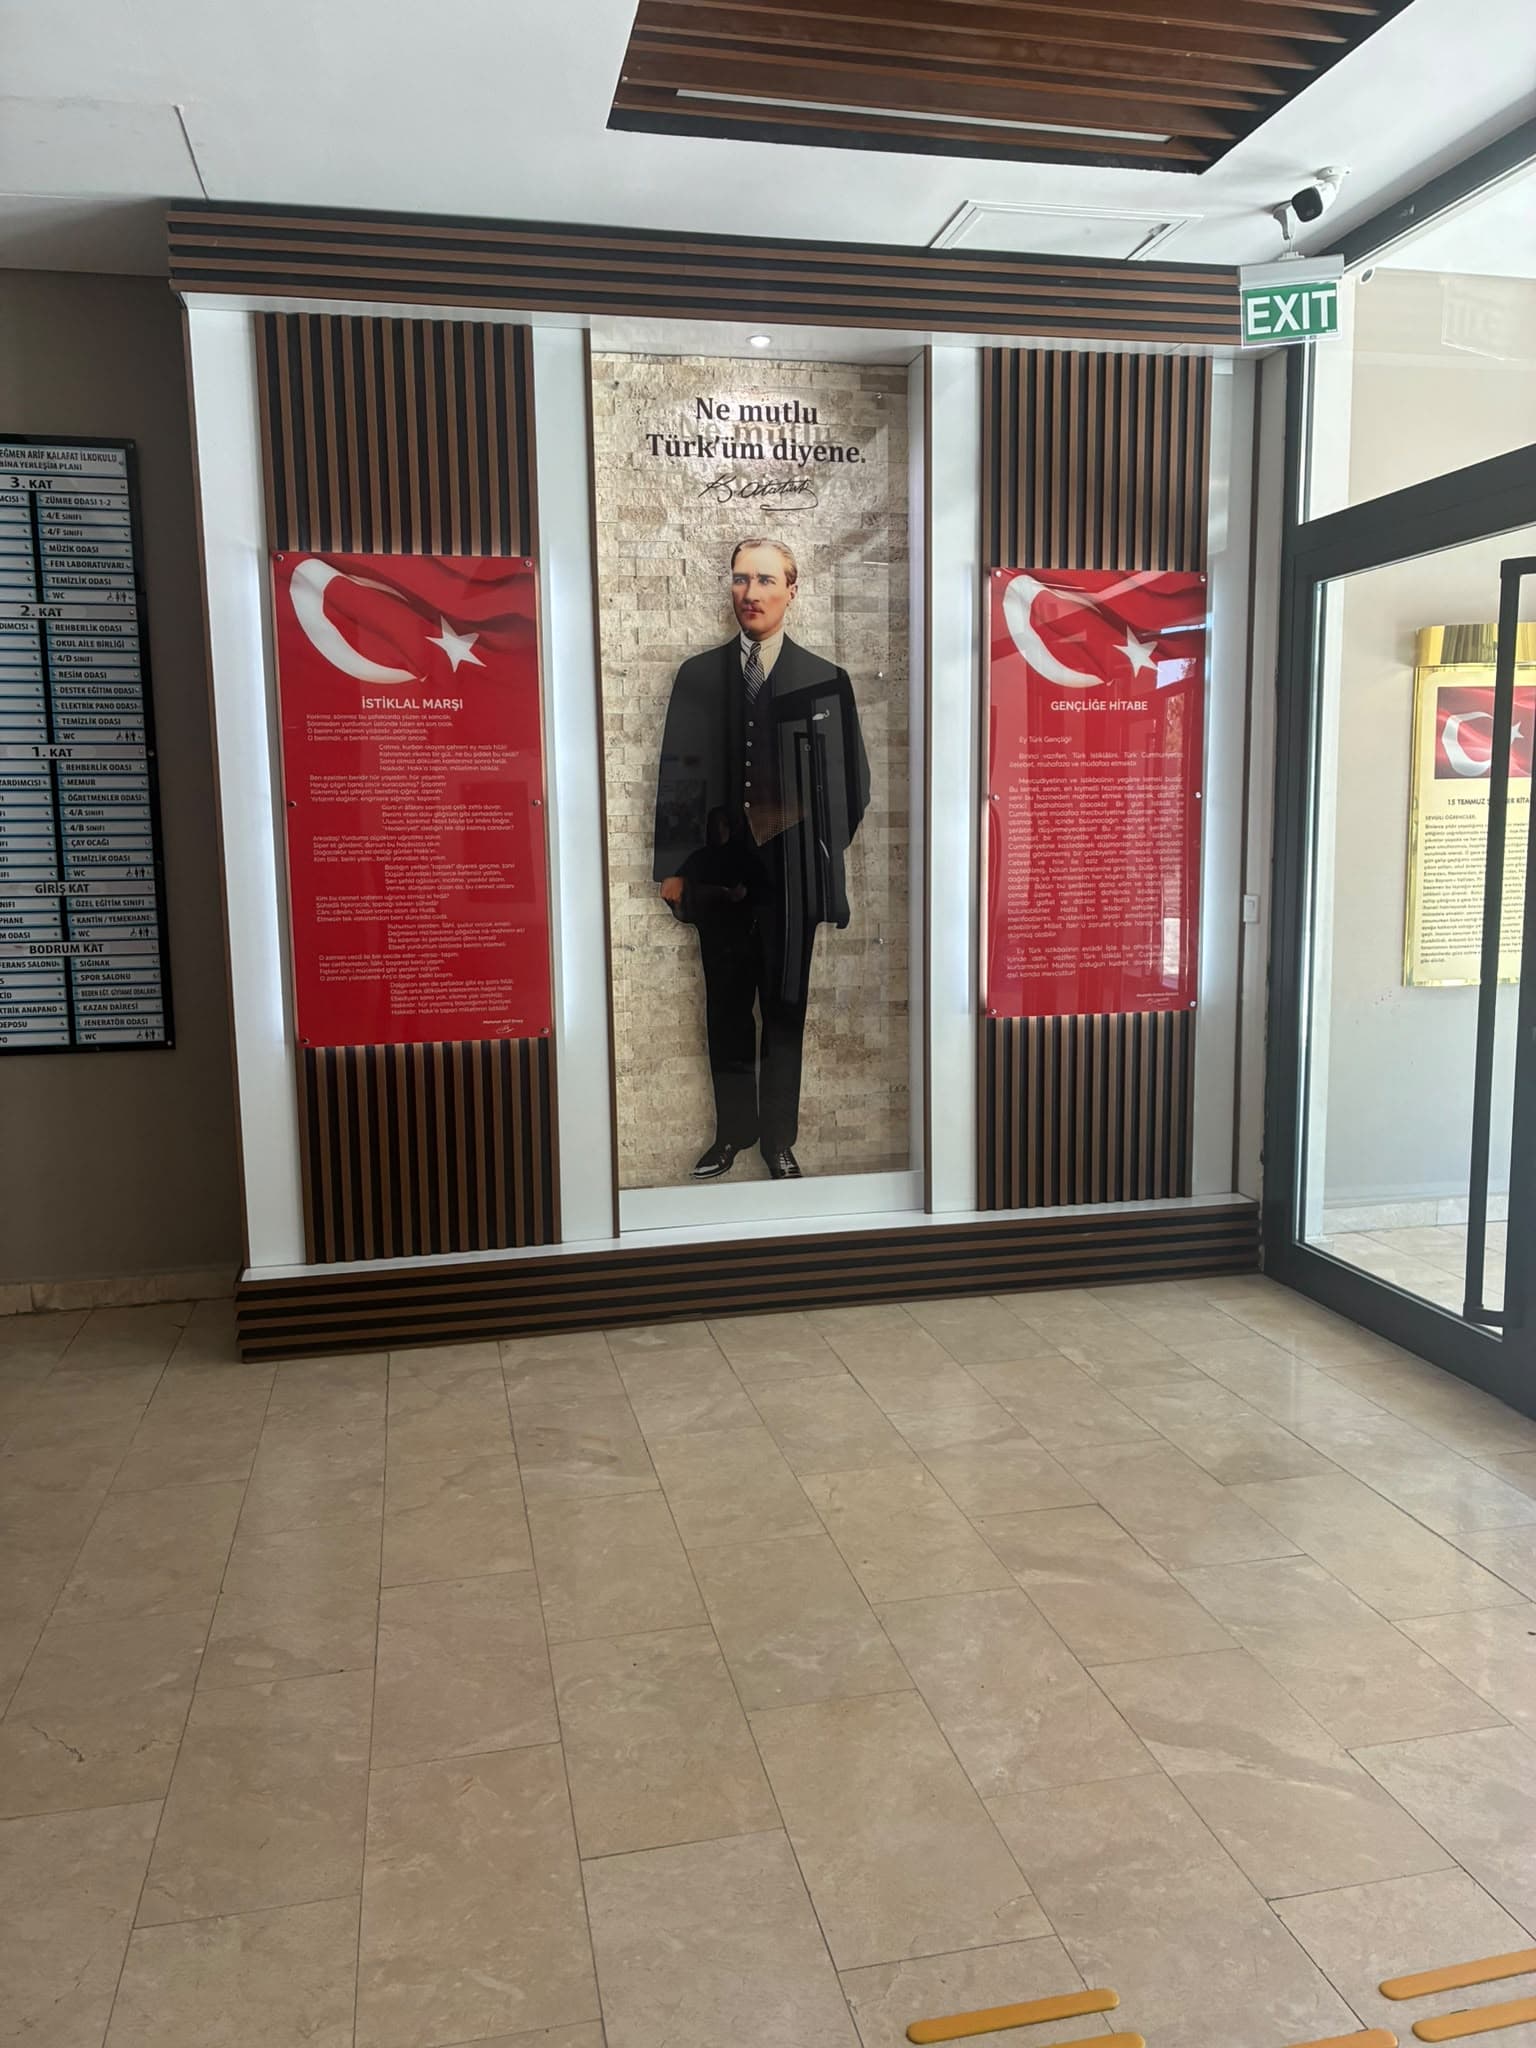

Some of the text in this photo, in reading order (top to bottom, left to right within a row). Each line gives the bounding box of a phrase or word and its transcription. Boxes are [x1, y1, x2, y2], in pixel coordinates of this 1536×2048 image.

[1246, 289, 1337, 337] EXIT
[695, 396, 818, 425] Ne mutlu
[645, 433, 867, 467] Türk'üm diyene.
[46, 450, 79, 462] KALAFAT
[80, 452, 118, 462] İLKOKULU
[10, 476, 53, 489] 3. KAT
[44, 495, 72, 505] ZÜMRE
[74, 497, 98, 506] ODASI
[48, 544, 74, 552] MÜZİK
[66, 560, 124, 569] LABORATUVARI
[51, 576, 87, 584] TEMİZLİK
[20, 604, 63, 617] 2. KAT
[55, 624, 98, 632] REHBERLİK
[78, 639, 95, 648] AİLE
[96, 639, 125, 648] BİRLİĞİ
[58, 670, 82, 678] RESİM
[87, 685, 112, 694] EĞİTİM
[60, 702, 94, 710] ELEKTRİK
[362, 696, 464, 712] İSTİKLAL MARŞI
[1050, 698, 1149, 712] GENÇLİĞE HİTABE
[62, 716, 96, 725] TEMİZLİK
[32, 746, 73, 758] 1. KAT
[66, 762, 108, 771] REHBERLİK
[68, 793, 120, 802] ÖĞRETMENLER
[69, 809, 84, 817] 4/A
[70, 824, 84, 832] 4/B
[71, 838, 110, 848] ÇAY OCAĞI
[72, 853, 108, 862] TEMİZLİK
[35, 882, 90, 896] GİRİŞ KAT
[76, 899, 94, 908] ÖZEL
[95, 898, 122, 908] EĞİTİM
[76, 915, 104, 924] KANTİN
[108, 914, 150, 923] YEMEKHANE
[30, 943, 104, 954] BODRUM KAT
[28, 960, 57, 968] SALONU
[80, 958, 110, 967] SIĞINAK
[102, 973, 132, 981] SALONU
[21, 1005, 58, 1014] ANAPANO
[82, 1001, 138, 1012] KAZAN DAİRESİ
[83, 1017, 125, 1026] JENERATÖR
